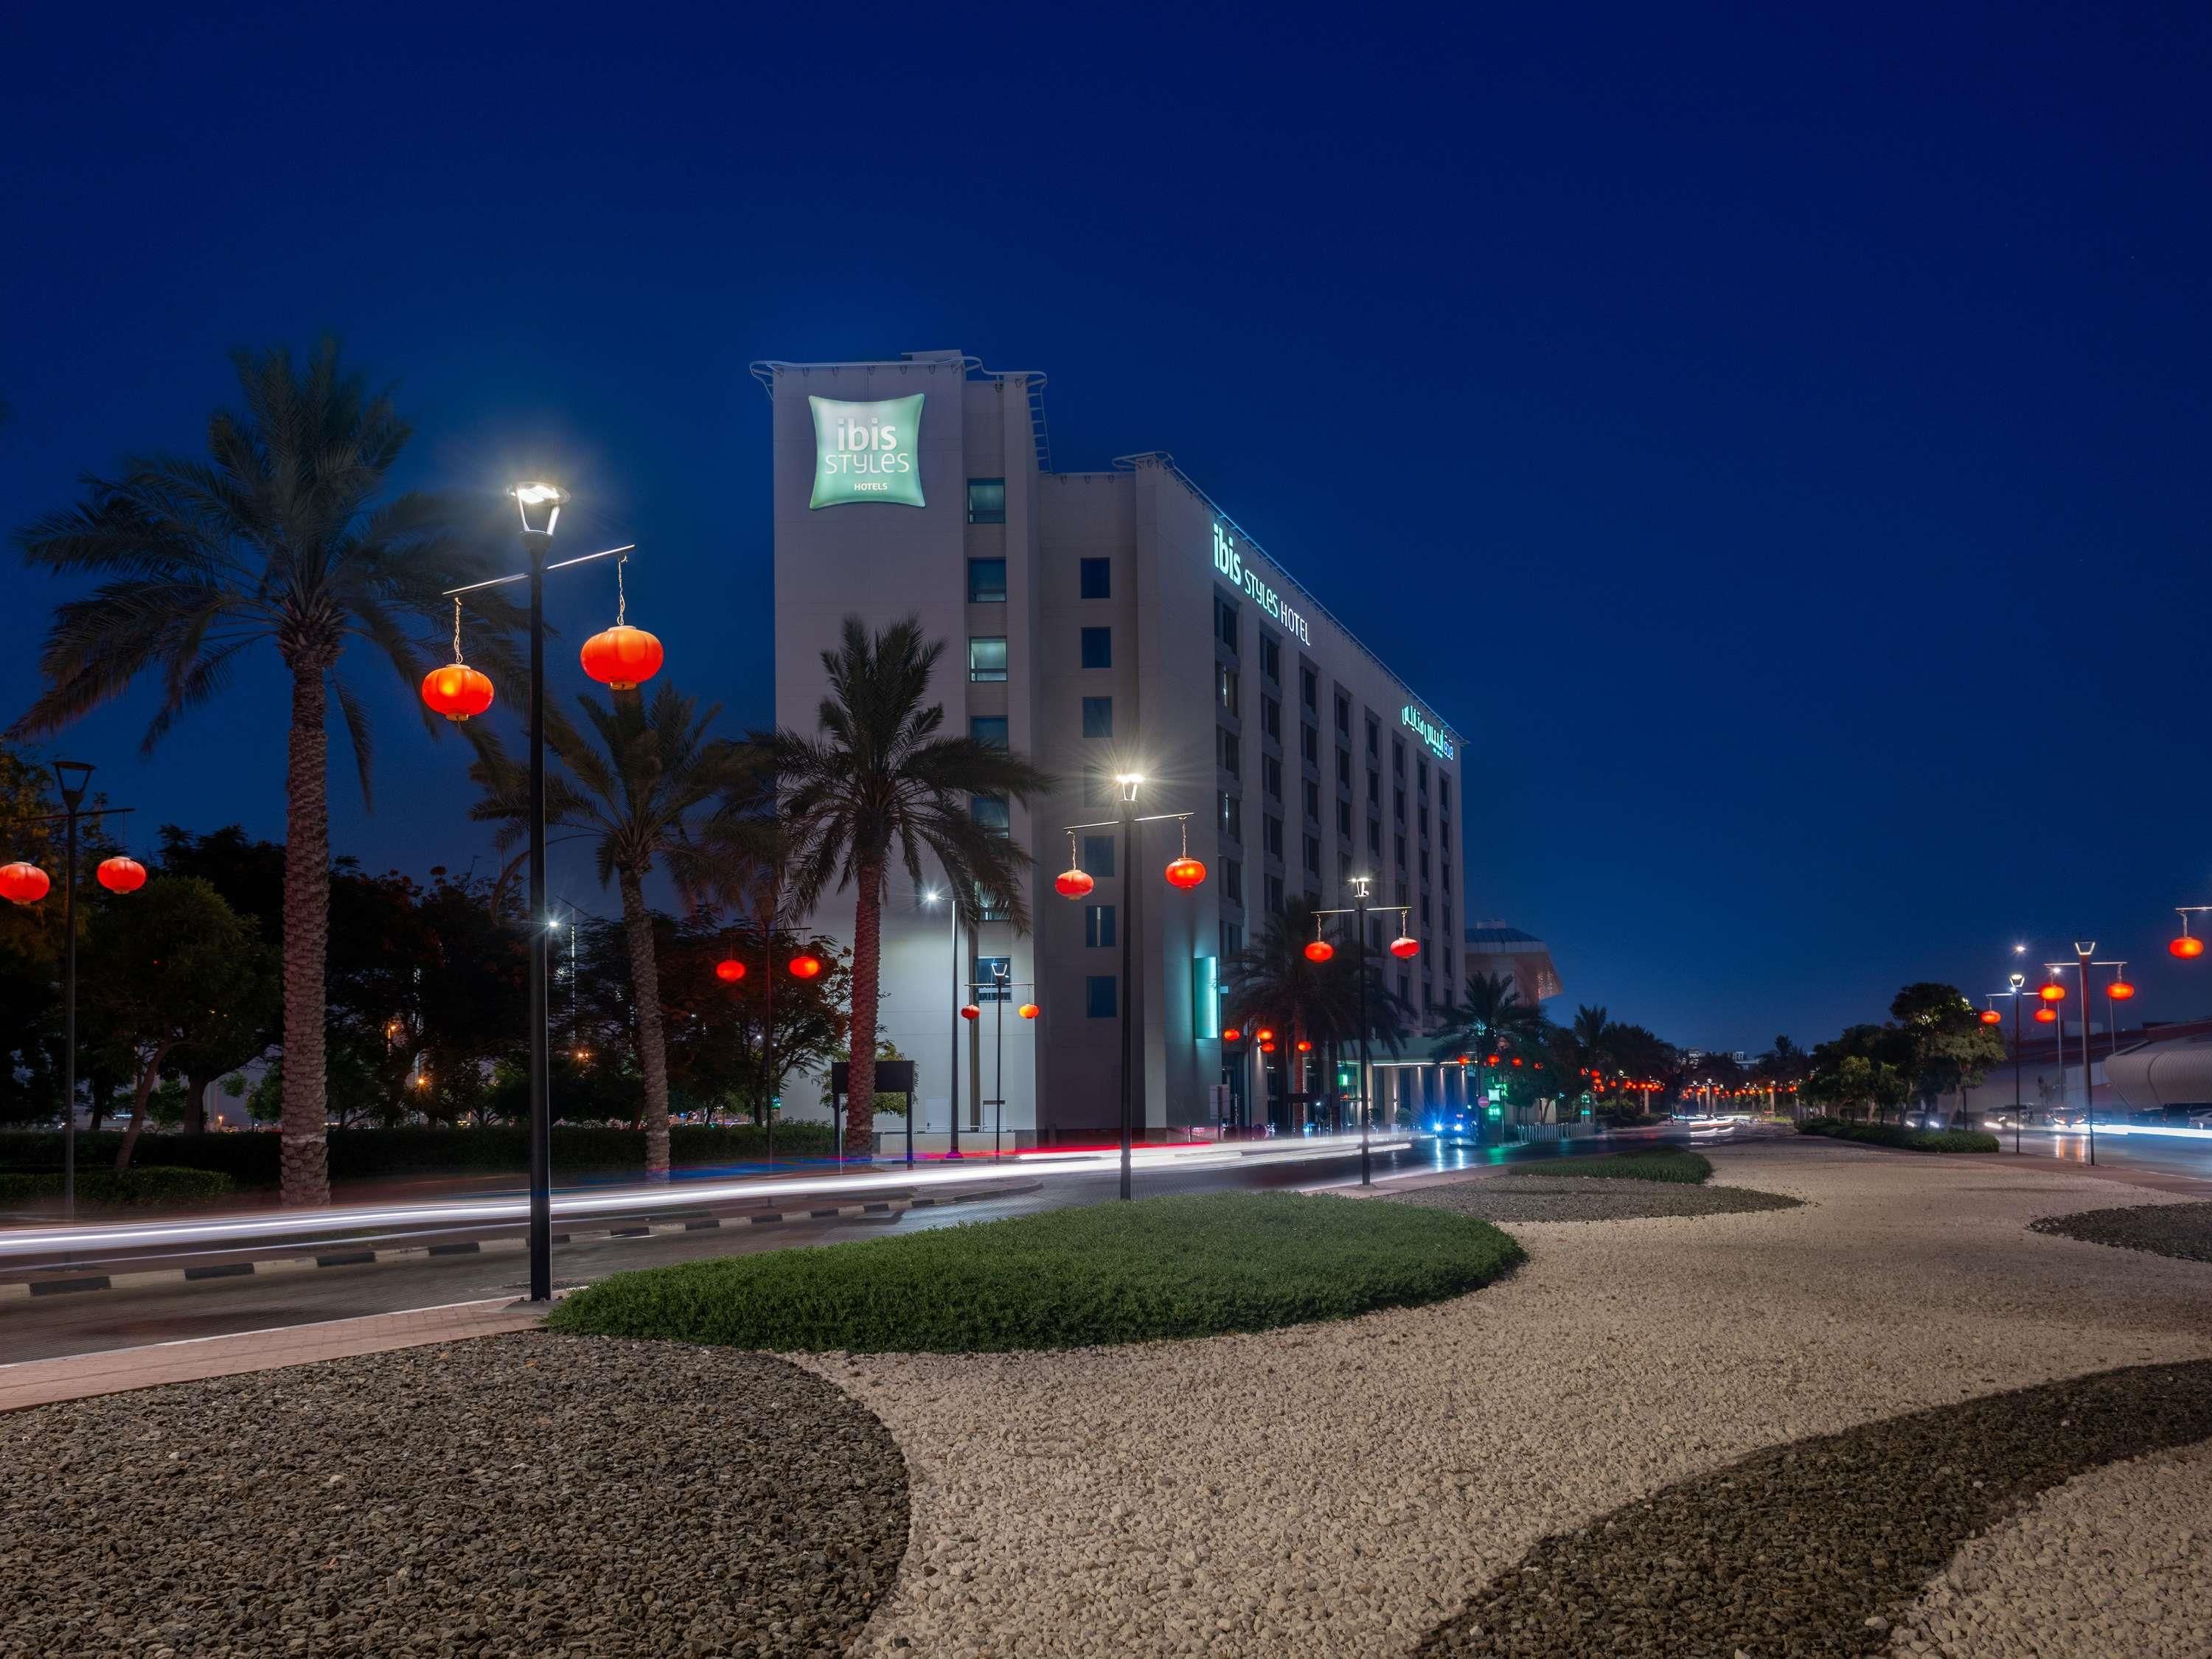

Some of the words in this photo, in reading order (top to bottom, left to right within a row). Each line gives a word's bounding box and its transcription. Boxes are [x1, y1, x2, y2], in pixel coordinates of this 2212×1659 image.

[838, 418, 897, 451] ibis
[1213, 523, 1242, 585] ibis
[1280, 600, 1310, 646] HOTEL
